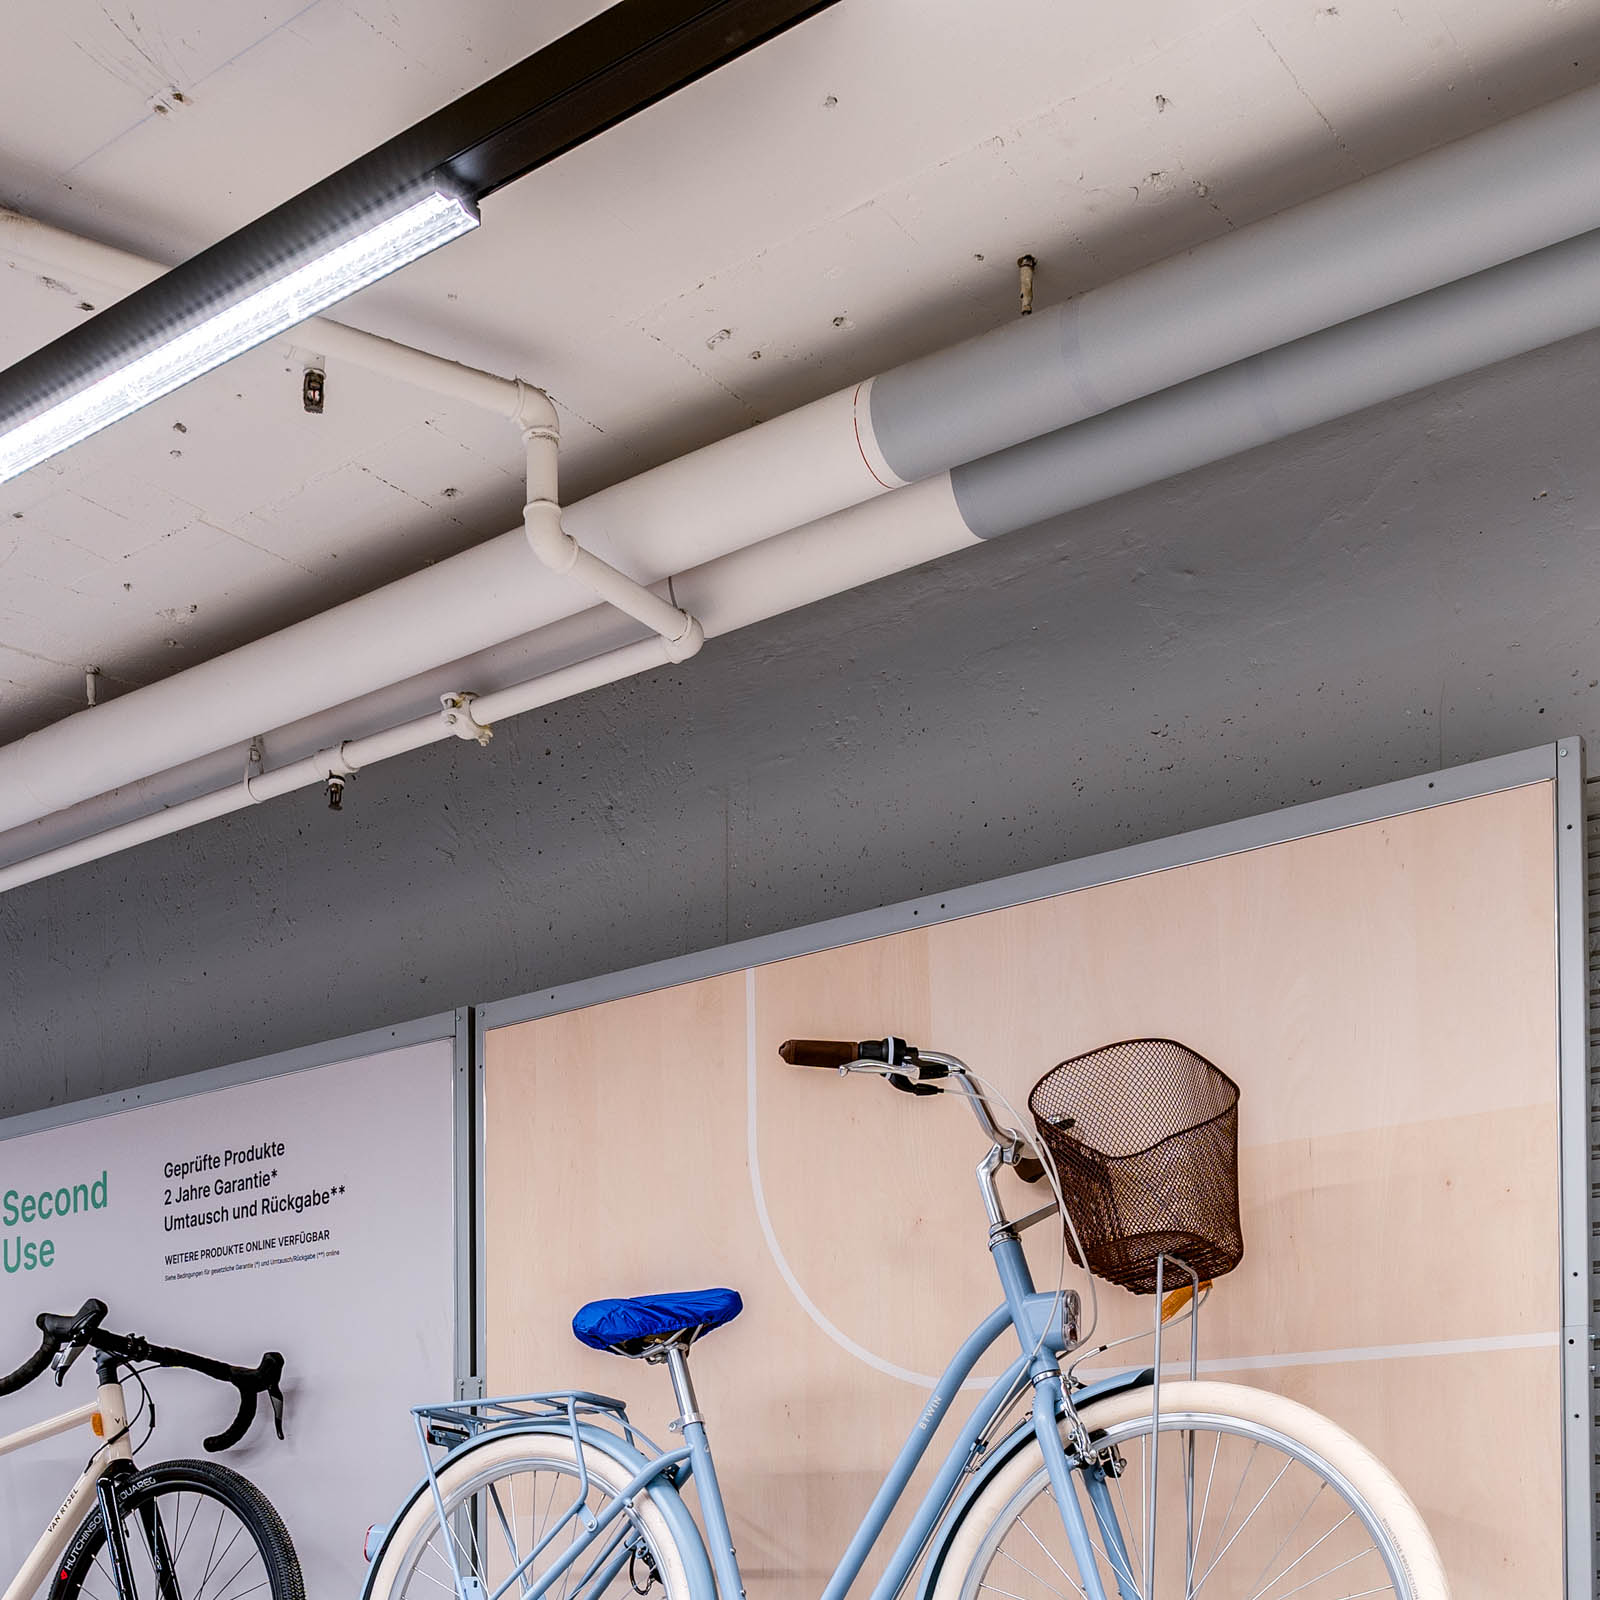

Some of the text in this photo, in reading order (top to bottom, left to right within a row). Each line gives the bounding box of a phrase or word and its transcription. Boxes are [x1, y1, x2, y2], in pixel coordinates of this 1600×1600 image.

[163, 1142, 285, 1180] Geprüfte Produkte
[2, 1170, 108, 1226] Second
[163, 1189, 173, 1206] 2
[174, 1182, 212, 1203] Jahre
[163, 1204, 229, 1232] Umtausch
[232, 1199, 258, 1222] und
[2, 1235, 55, 1274] Use
[165, 1229, 330, 1266] WEITERE PRODUKTE ONLINE VERFÜGBAR
[177, 1270, 203, 1281] Bedingungen
[211, 1265, 235, 1276] gesetzliche
[235, 1263, 254, 1271] Garantie
[919, 1395, 942, 1430] BTWIN
[119, 1477, 156, 1501] OUAREG
[48, 1488, 79, 1533] VAN RYSEL
[64, 1512, 104, 1571] HUTCHINSON
[1401, 1554, 1420, 1600] PROTECTION
